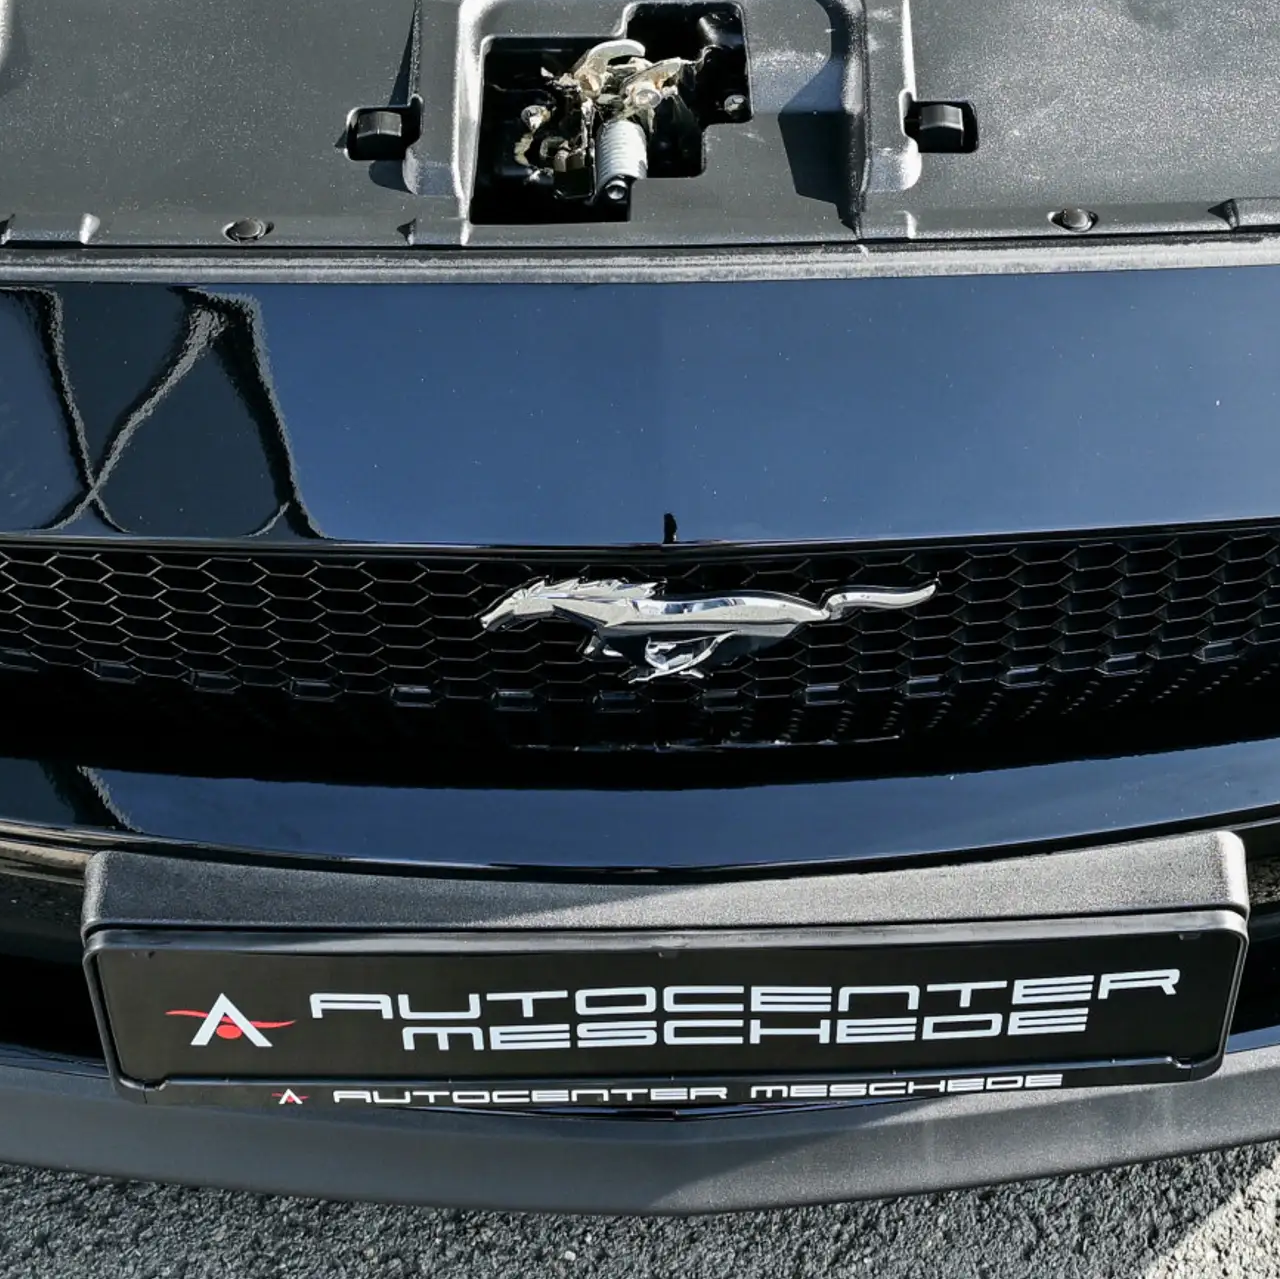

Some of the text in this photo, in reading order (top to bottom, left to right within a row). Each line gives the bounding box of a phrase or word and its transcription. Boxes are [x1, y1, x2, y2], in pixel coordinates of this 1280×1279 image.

[309, 968, 1181, 1020] AUTOCENTER
[402, 1007, 1089, 1052] MESCHEDE
[332, 1084, 728, 1104] AUTOCENTER
[749, 1073, 1064, 1100] MESCHEDE
